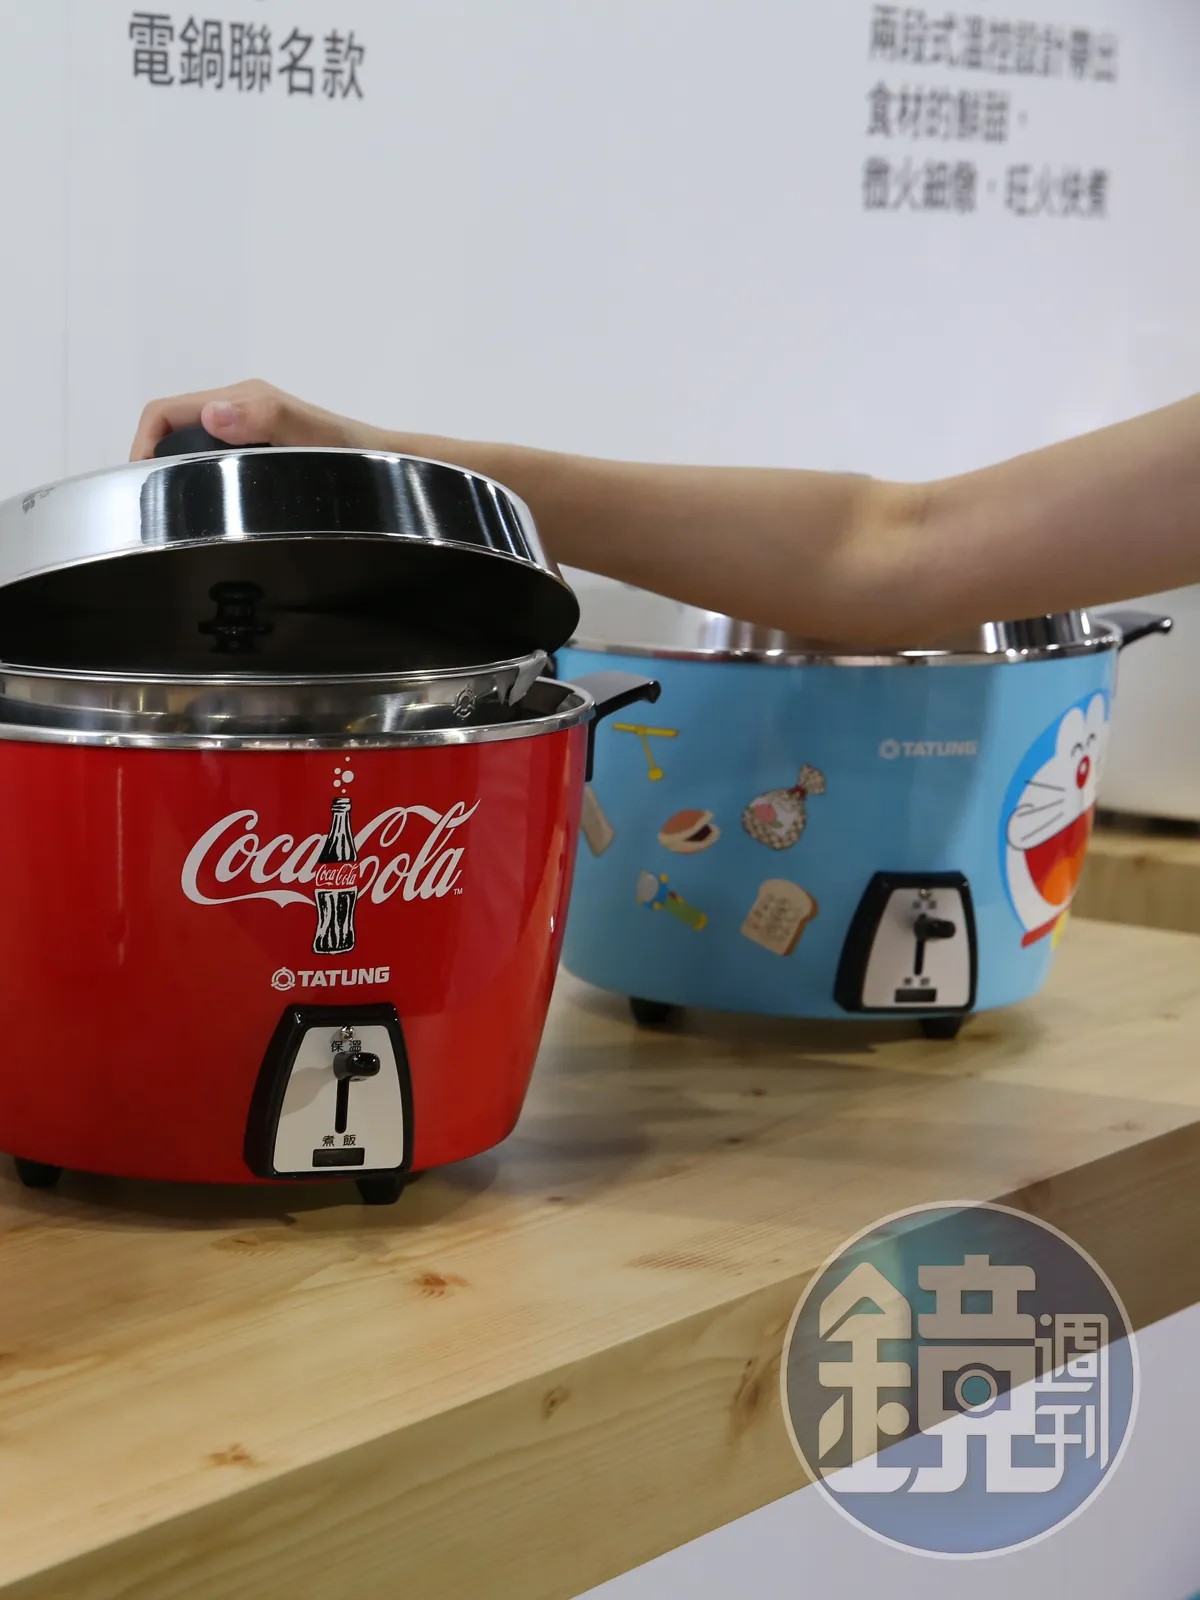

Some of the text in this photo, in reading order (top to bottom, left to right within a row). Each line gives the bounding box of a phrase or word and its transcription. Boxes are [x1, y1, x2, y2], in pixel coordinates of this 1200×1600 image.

[129, 11, 365, 100] 電鍋聯名款
[902, 740, 978, 757] TATUNG
[297, 966, 390, 988] TATUNG
[330, 1039, 363, 1053] 保溫
[322, 1134, 357, 1147] 煮飯
